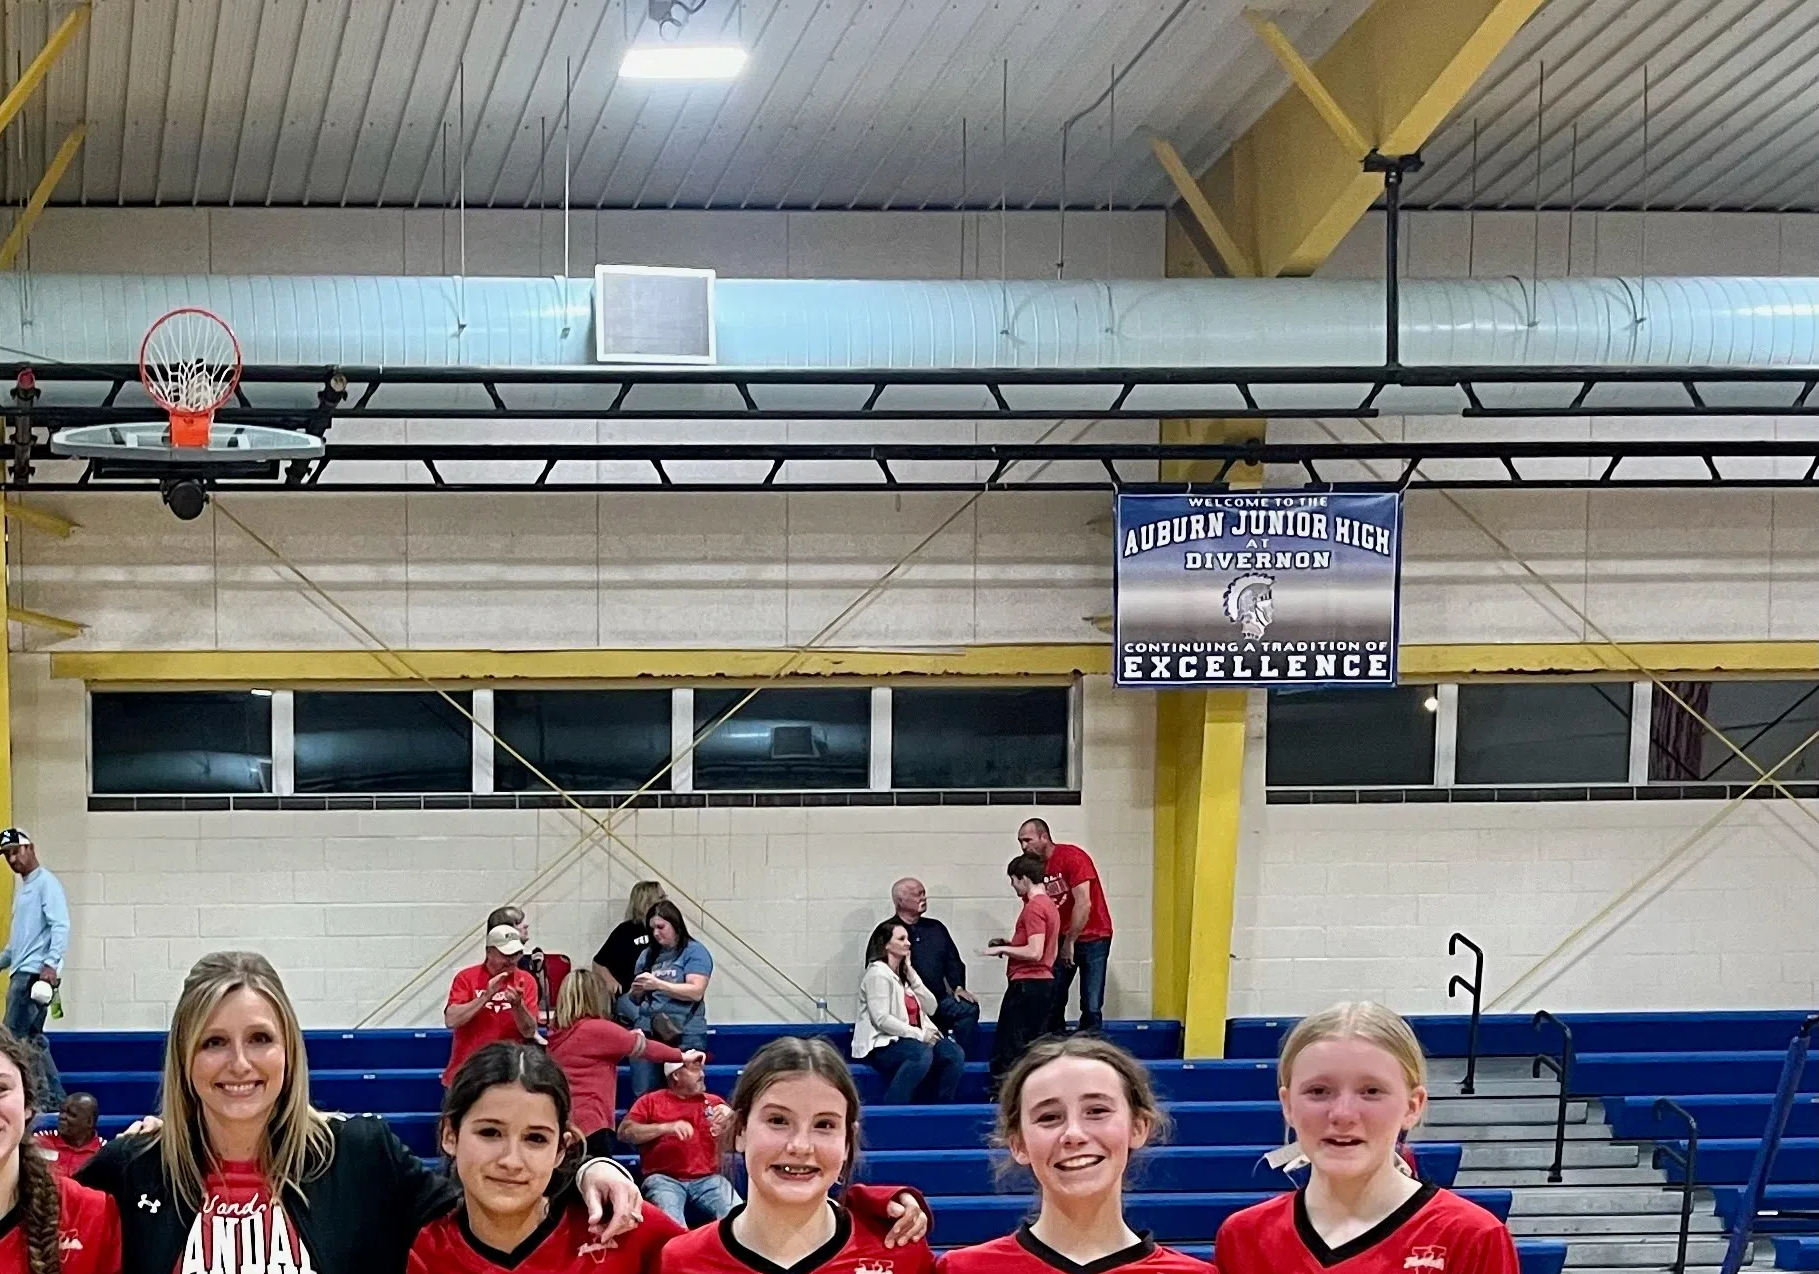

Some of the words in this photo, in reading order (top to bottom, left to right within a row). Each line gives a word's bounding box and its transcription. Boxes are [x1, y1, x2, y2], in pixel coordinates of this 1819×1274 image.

[1188, 497, 1270, 508] WELCOME
[1274, 497, 1293, 507] TO
[1299, 497, 1328, 507] THE
[1123, 511, 1225, 557] AUBURN
[1231, 509, 1328, 539] JUNIOR
[1335, 516, 1390, 556] HIGH
[1245, 538, 1269, 549] AT
[1184, 550, 1331, 570] DIVERNON
[1124, 641, 1239, 653] CONTINUING
[1243, 642, 1257, 652] A
[1262, 641, 1361, 652] TRADITION
[1365, 641, 1388, 651] OF
[1122, 654, 1388, 679] EXCELLENCE
